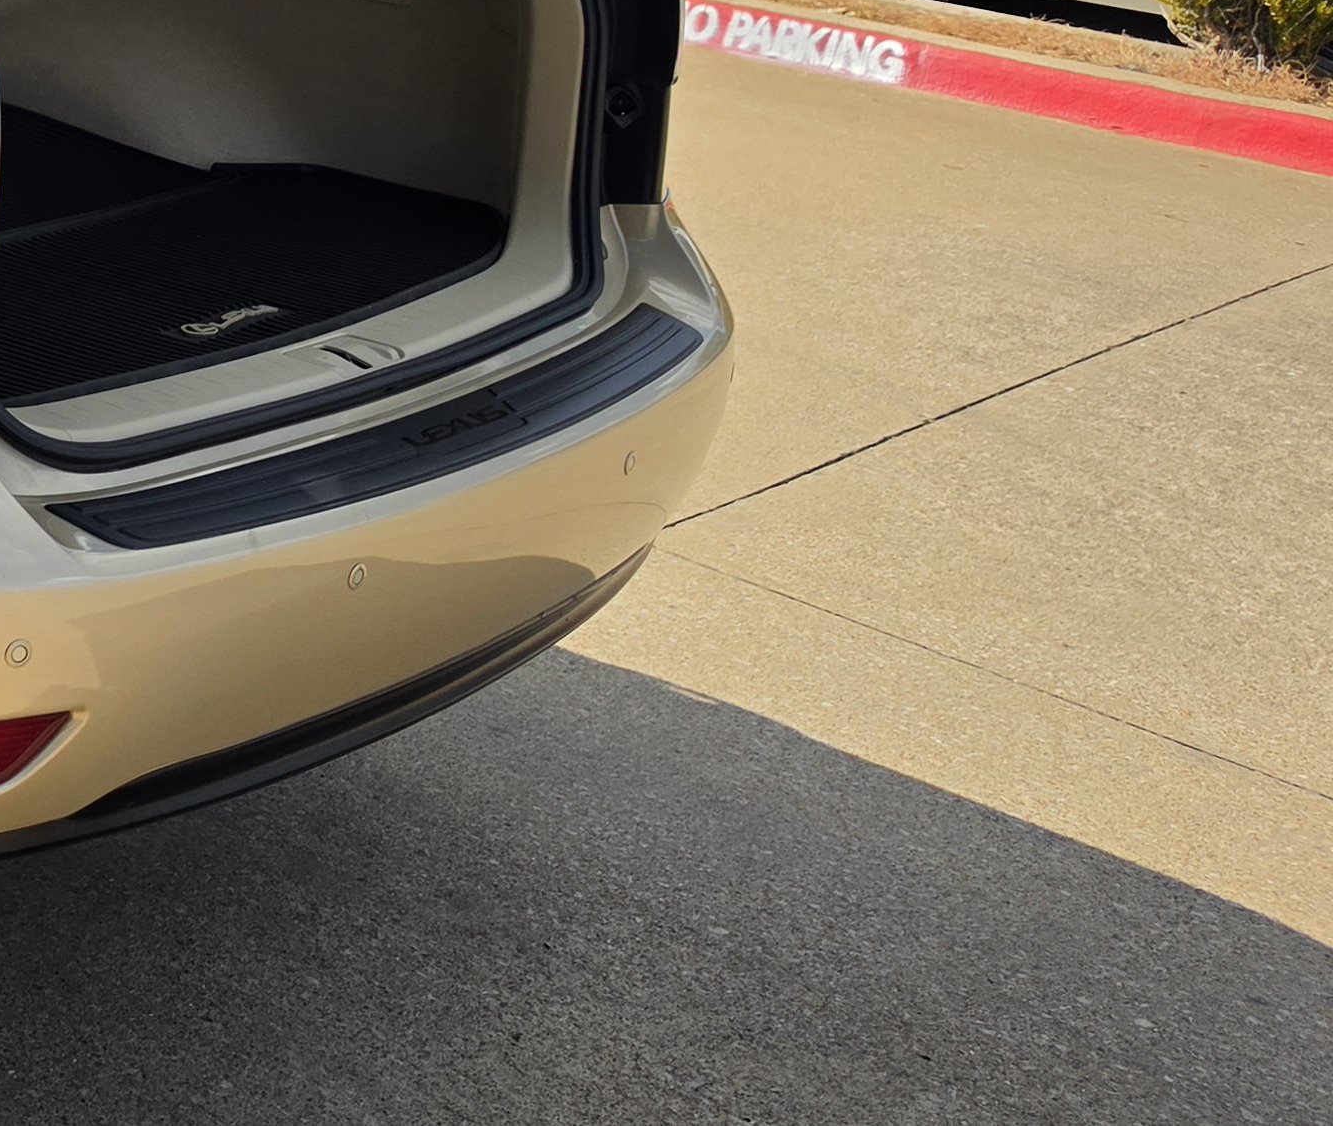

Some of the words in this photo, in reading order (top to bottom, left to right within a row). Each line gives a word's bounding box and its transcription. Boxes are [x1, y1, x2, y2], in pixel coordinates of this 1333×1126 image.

[685, 0, 720, 42] O
[723, 10, 906, 84] PARKING
[401, 407, 509, 446] LEXUS
